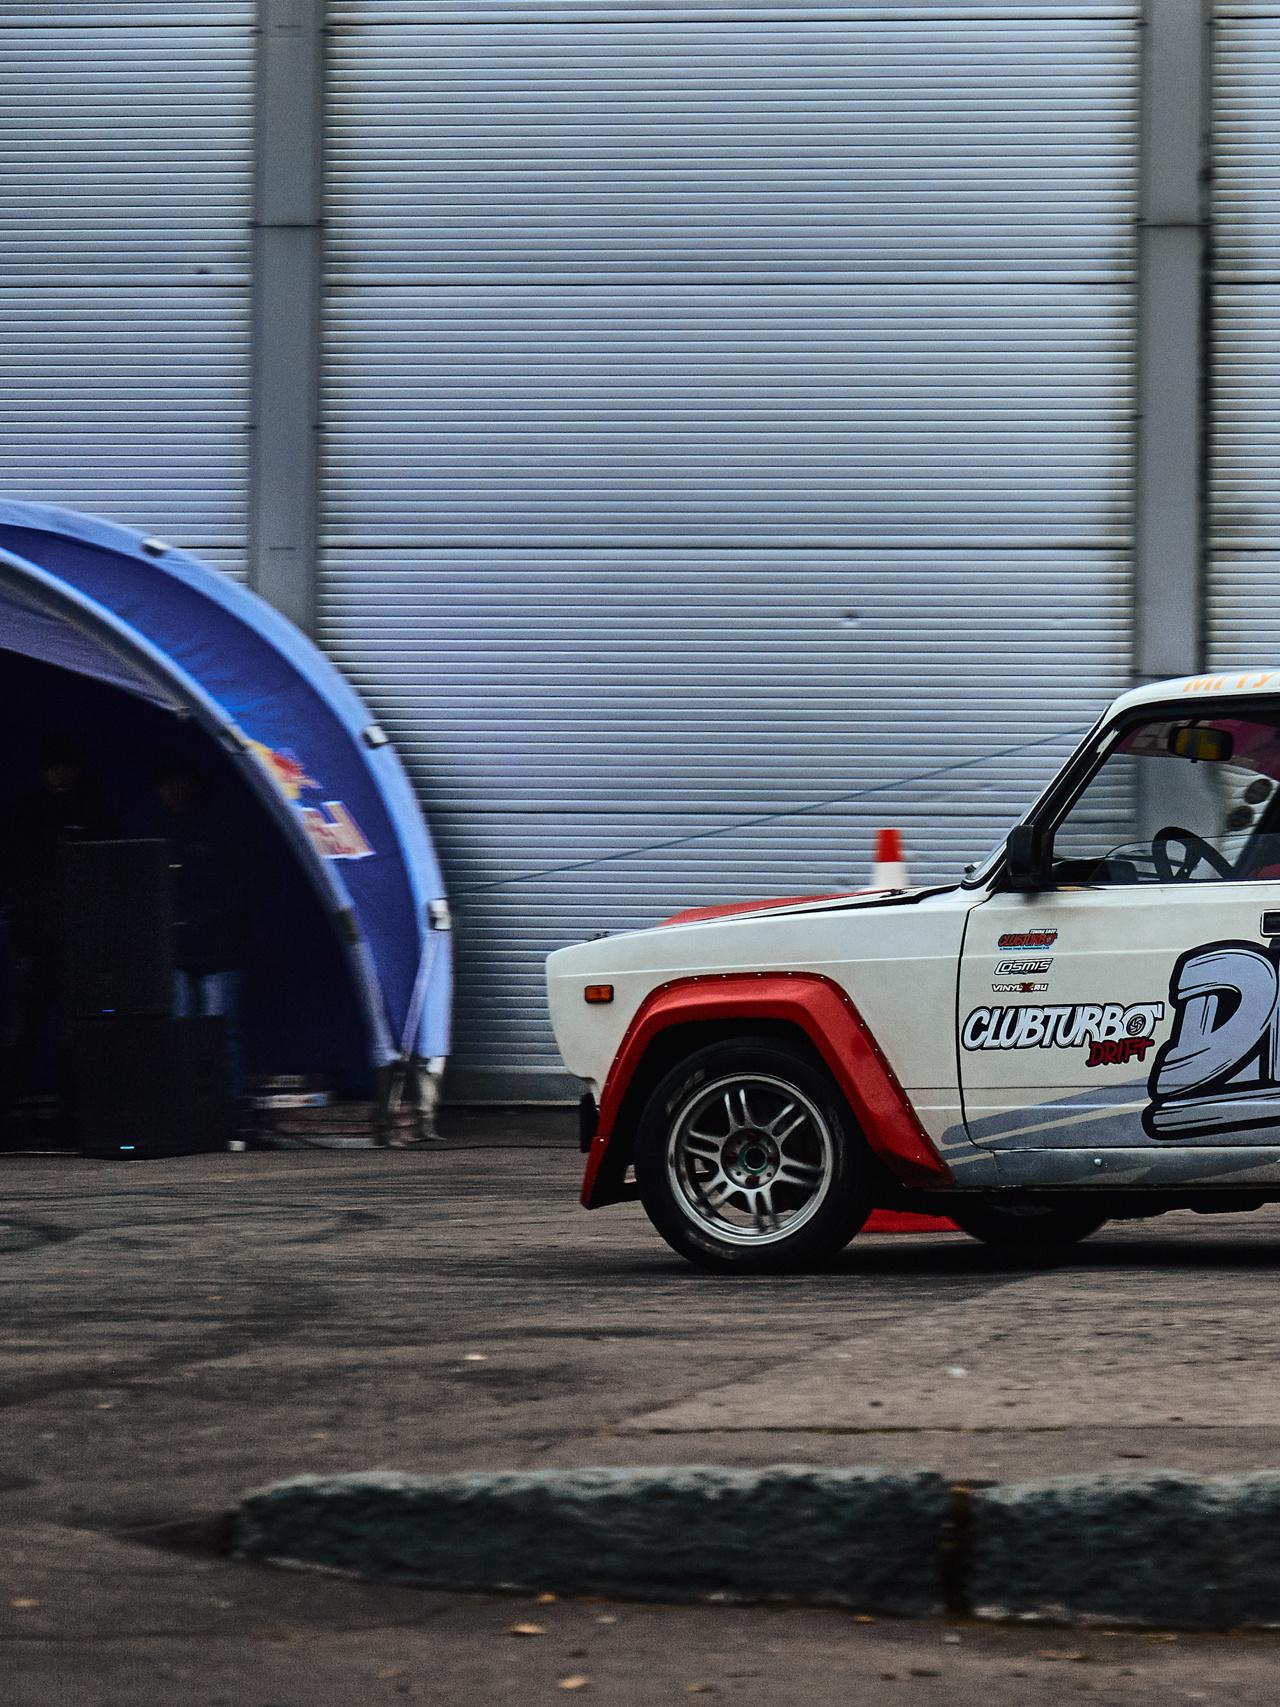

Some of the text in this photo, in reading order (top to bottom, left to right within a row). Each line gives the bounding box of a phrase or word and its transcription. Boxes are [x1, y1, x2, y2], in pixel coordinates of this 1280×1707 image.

[998, 933, 1058, 947] CLUBTURBO
[962, 1002, 1165, 1051] CLUBTURBO
[1085, 1036, 1156, 1067] DRIFT
